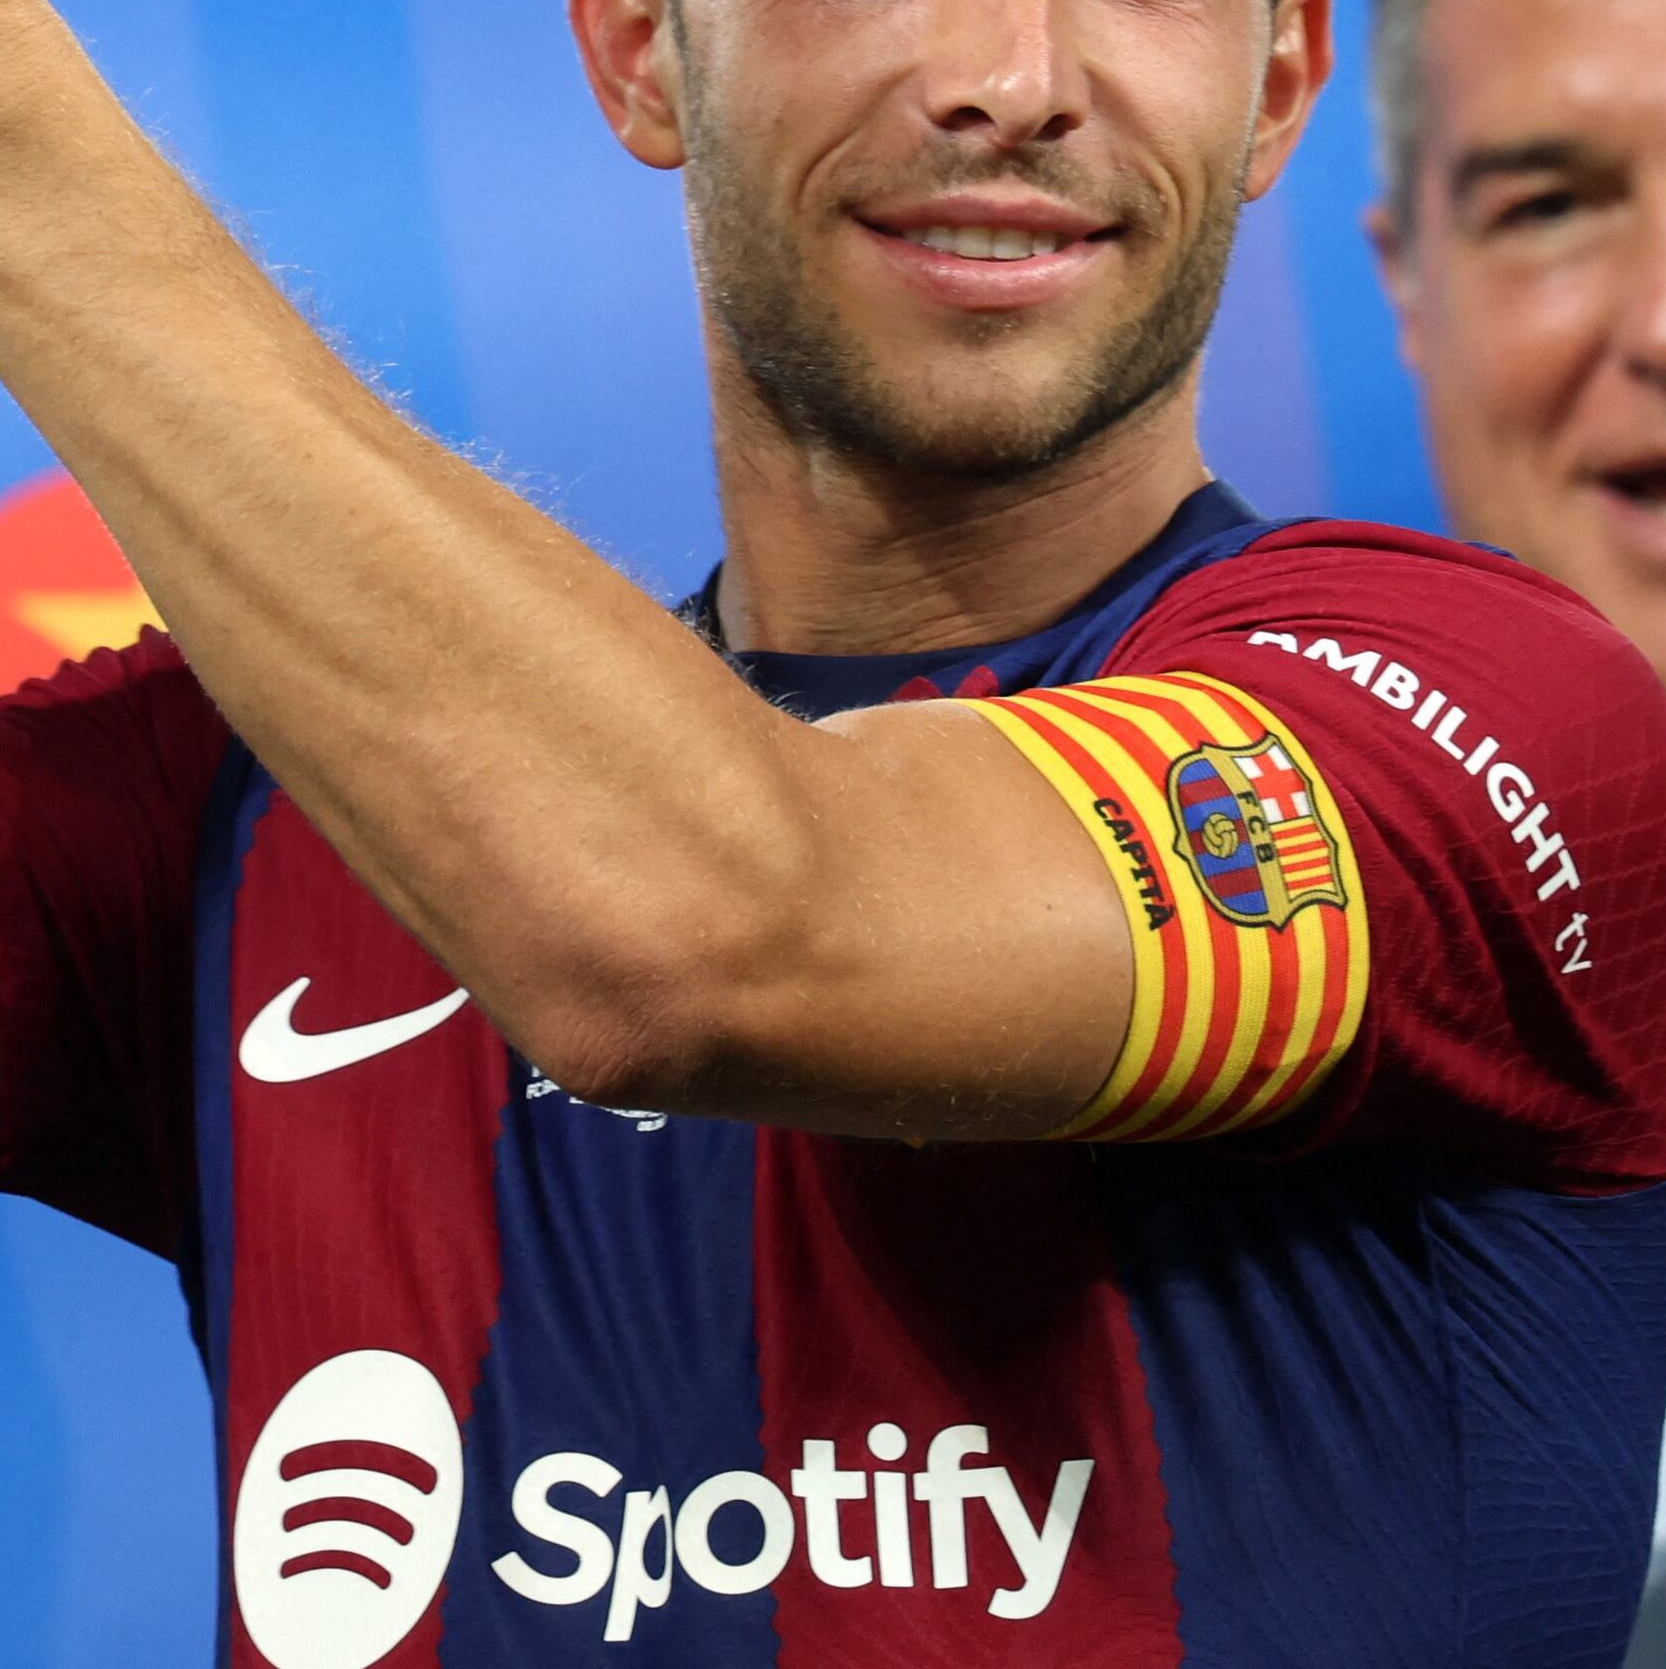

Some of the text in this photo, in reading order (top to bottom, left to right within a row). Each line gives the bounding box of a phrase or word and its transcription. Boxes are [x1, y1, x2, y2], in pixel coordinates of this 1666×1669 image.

[1247, 630, 1593, 975] AMBILIGHT tv
[490, 1420, 1095, 1643] Spotify
